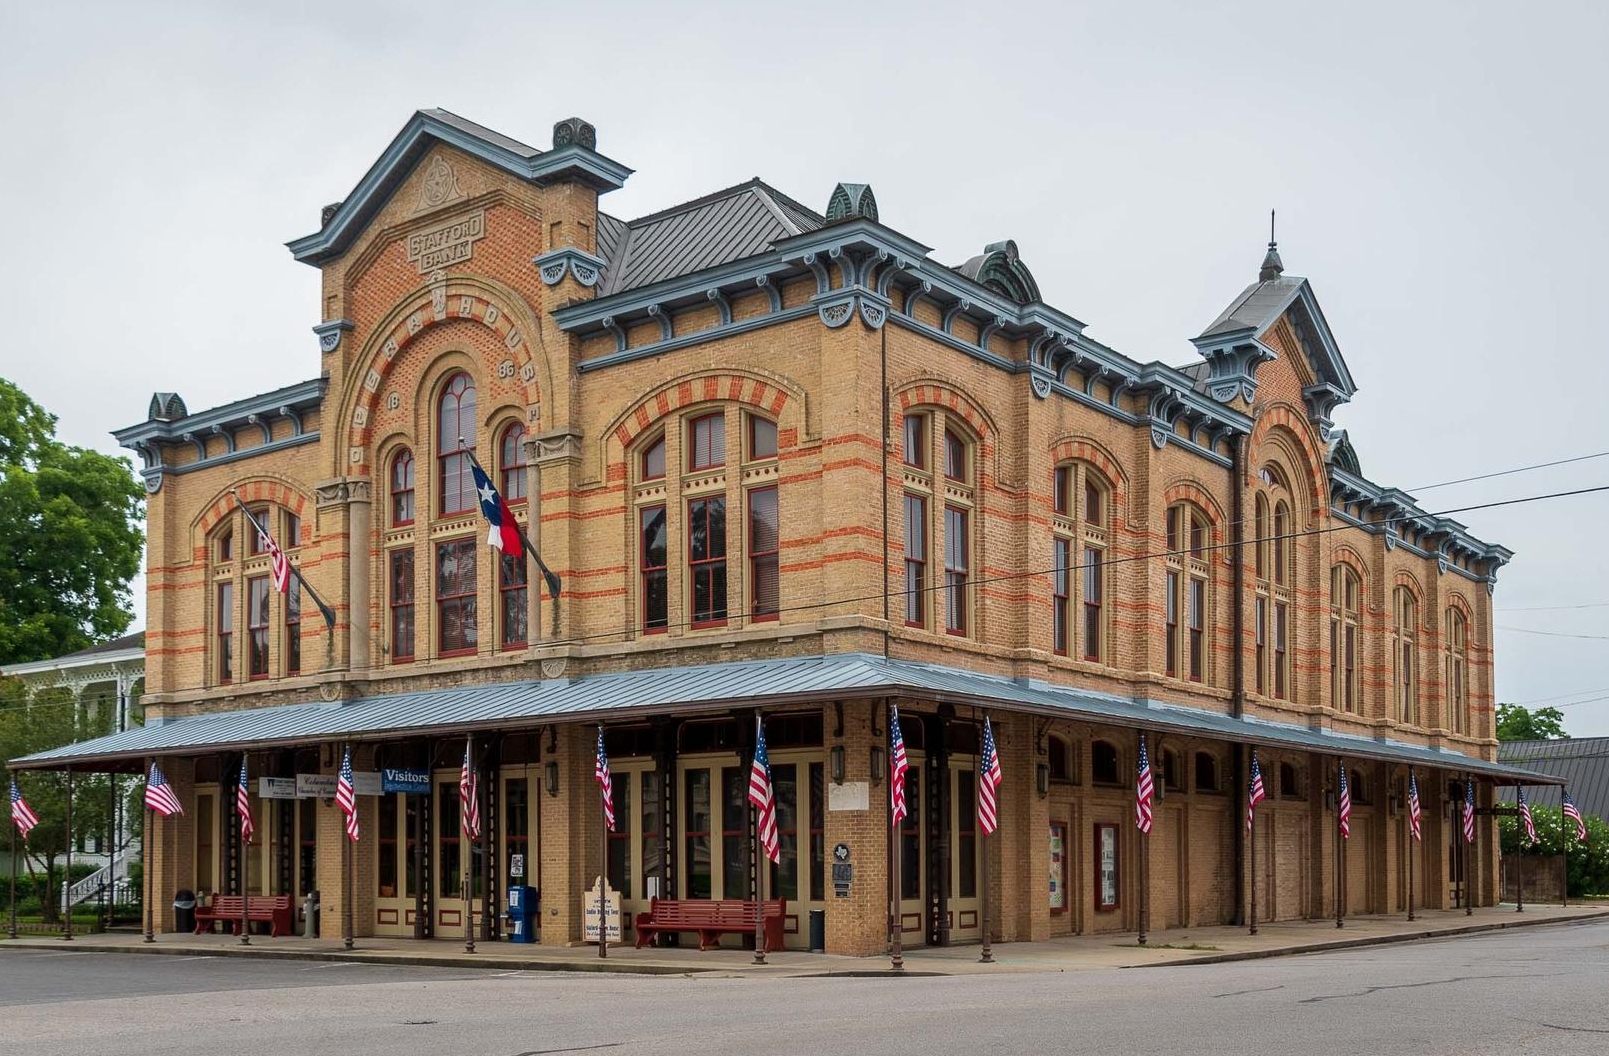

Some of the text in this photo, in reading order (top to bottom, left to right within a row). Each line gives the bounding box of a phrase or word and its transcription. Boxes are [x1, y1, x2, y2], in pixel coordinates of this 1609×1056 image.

[411, 218, 481, 256] STAFFORD
[423, 242, 469, 270] BANK
[498, 360, 515, 378] 86
[387, 392, 400, 410] 18
[385, 769, 430, 783] Visitors
